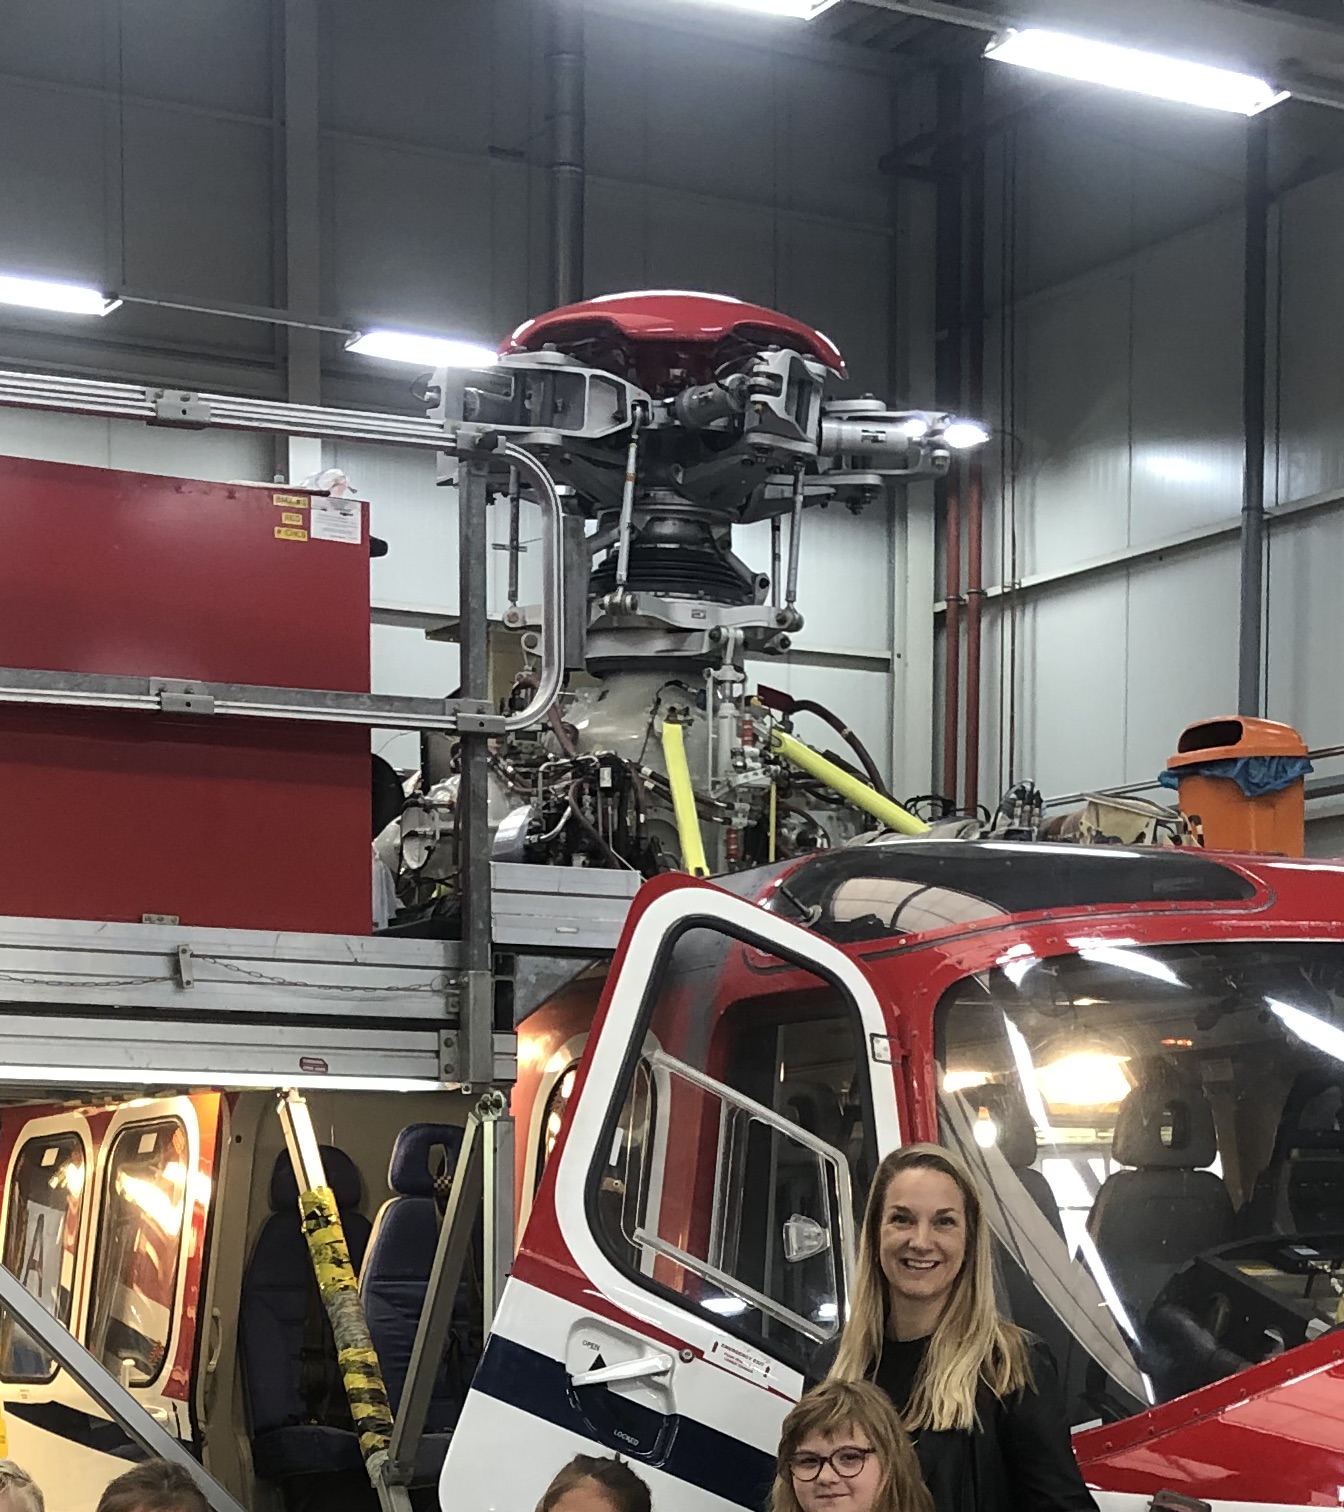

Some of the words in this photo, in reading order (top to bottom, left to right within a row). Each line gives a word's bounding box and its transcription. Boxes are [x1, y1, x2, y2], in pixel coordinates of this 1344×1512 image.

[582, 1339, 601, 1352] OPEN
[720, 1343, 753, 1361] EMERGENCY
[752, 1358, 765, 1367] EXIT
[613, 1429, 640, 1447] LOCKED
